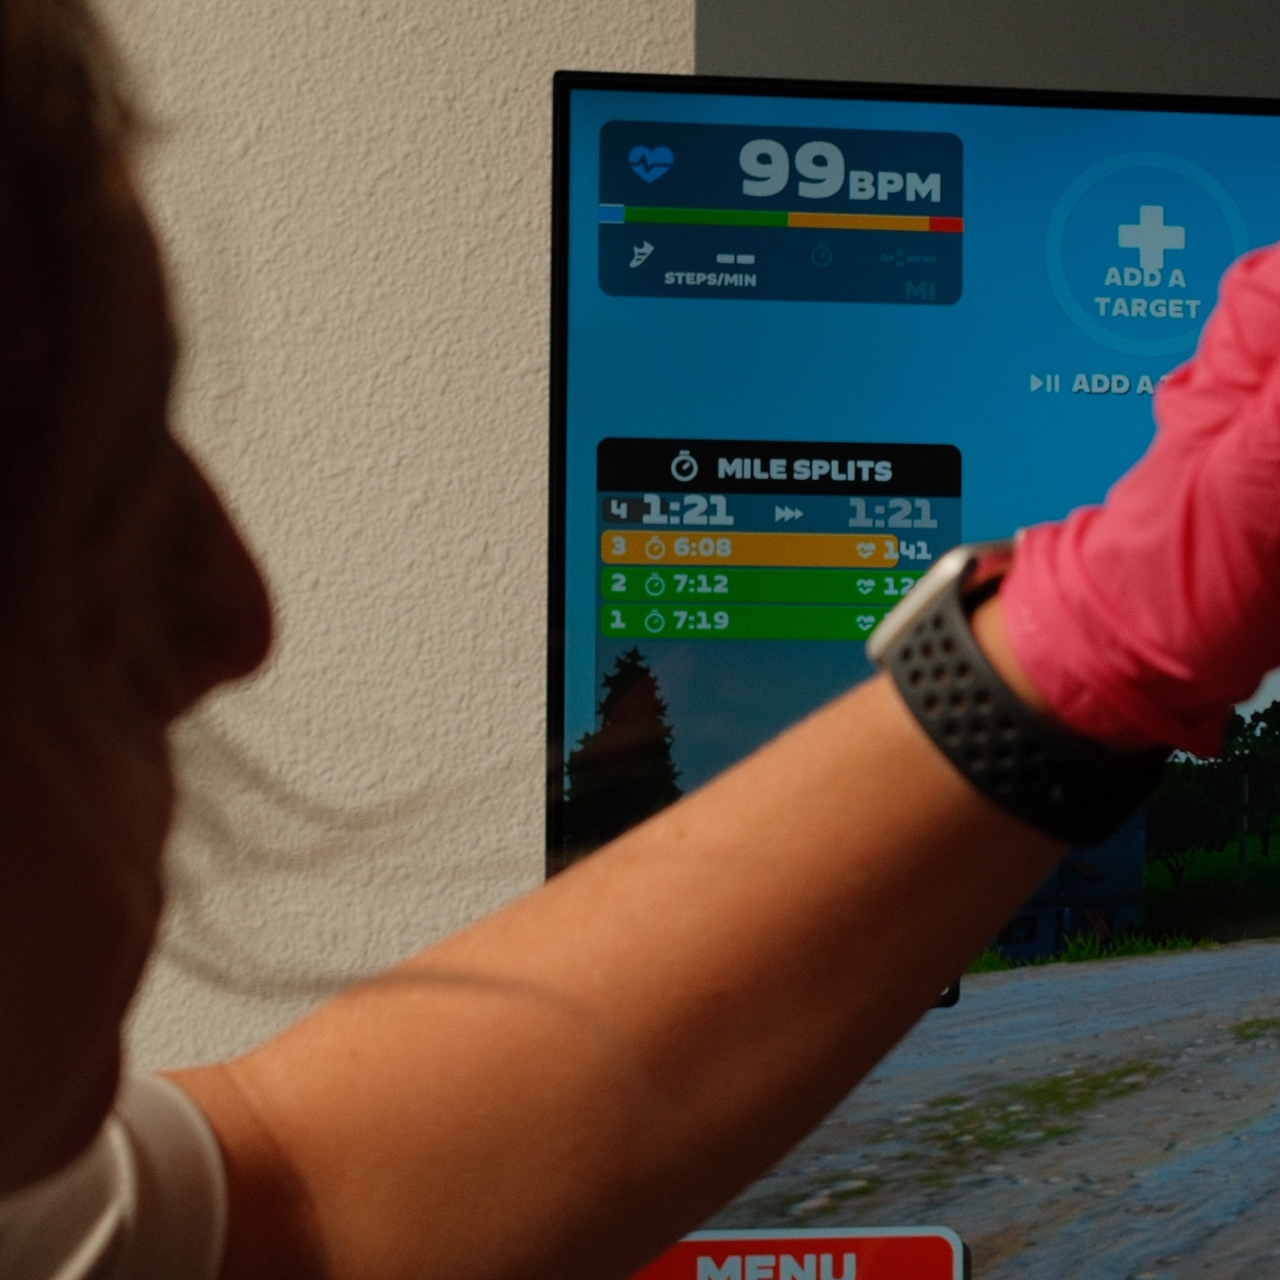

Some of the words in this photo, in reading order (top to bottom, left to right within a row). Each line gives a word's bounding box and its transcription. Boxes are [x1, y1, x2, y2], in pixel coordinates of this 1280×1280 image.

[738, 138, 846, 200] 99
[848, 169, 942, 203] BPM
[664, 271, 757, 288] STEPS/MIN
[1104, 266, 1162, 288] ADD
[1168, 268, 1187, 289] A
[904, 280, 937, 301] MI
[1094, 296, 1202, 319] TARGET
[1071, 373, 1131, 395] ADD
[1136, 374, 1155, 395] A
[717, 457, 788, 481] MILE
[792, 458, 893, 483] SPLITS
[609, 499, 628, 519] 4
[642, 493, 735, 527] 1:21
[847, 496, 939, 529] 1:21
[611, 536, 627, 556] 3
[673, 536, 733, 558] 6:08
[883, 540, 932, 561] 141
[610, 573, 627, 593] 2
[673, 573, 730, 594] 7:12
[883, 576, 917, 596] 12
[609, 610, 626, 629] 1
[673, 610, 730, 631] 7:19
